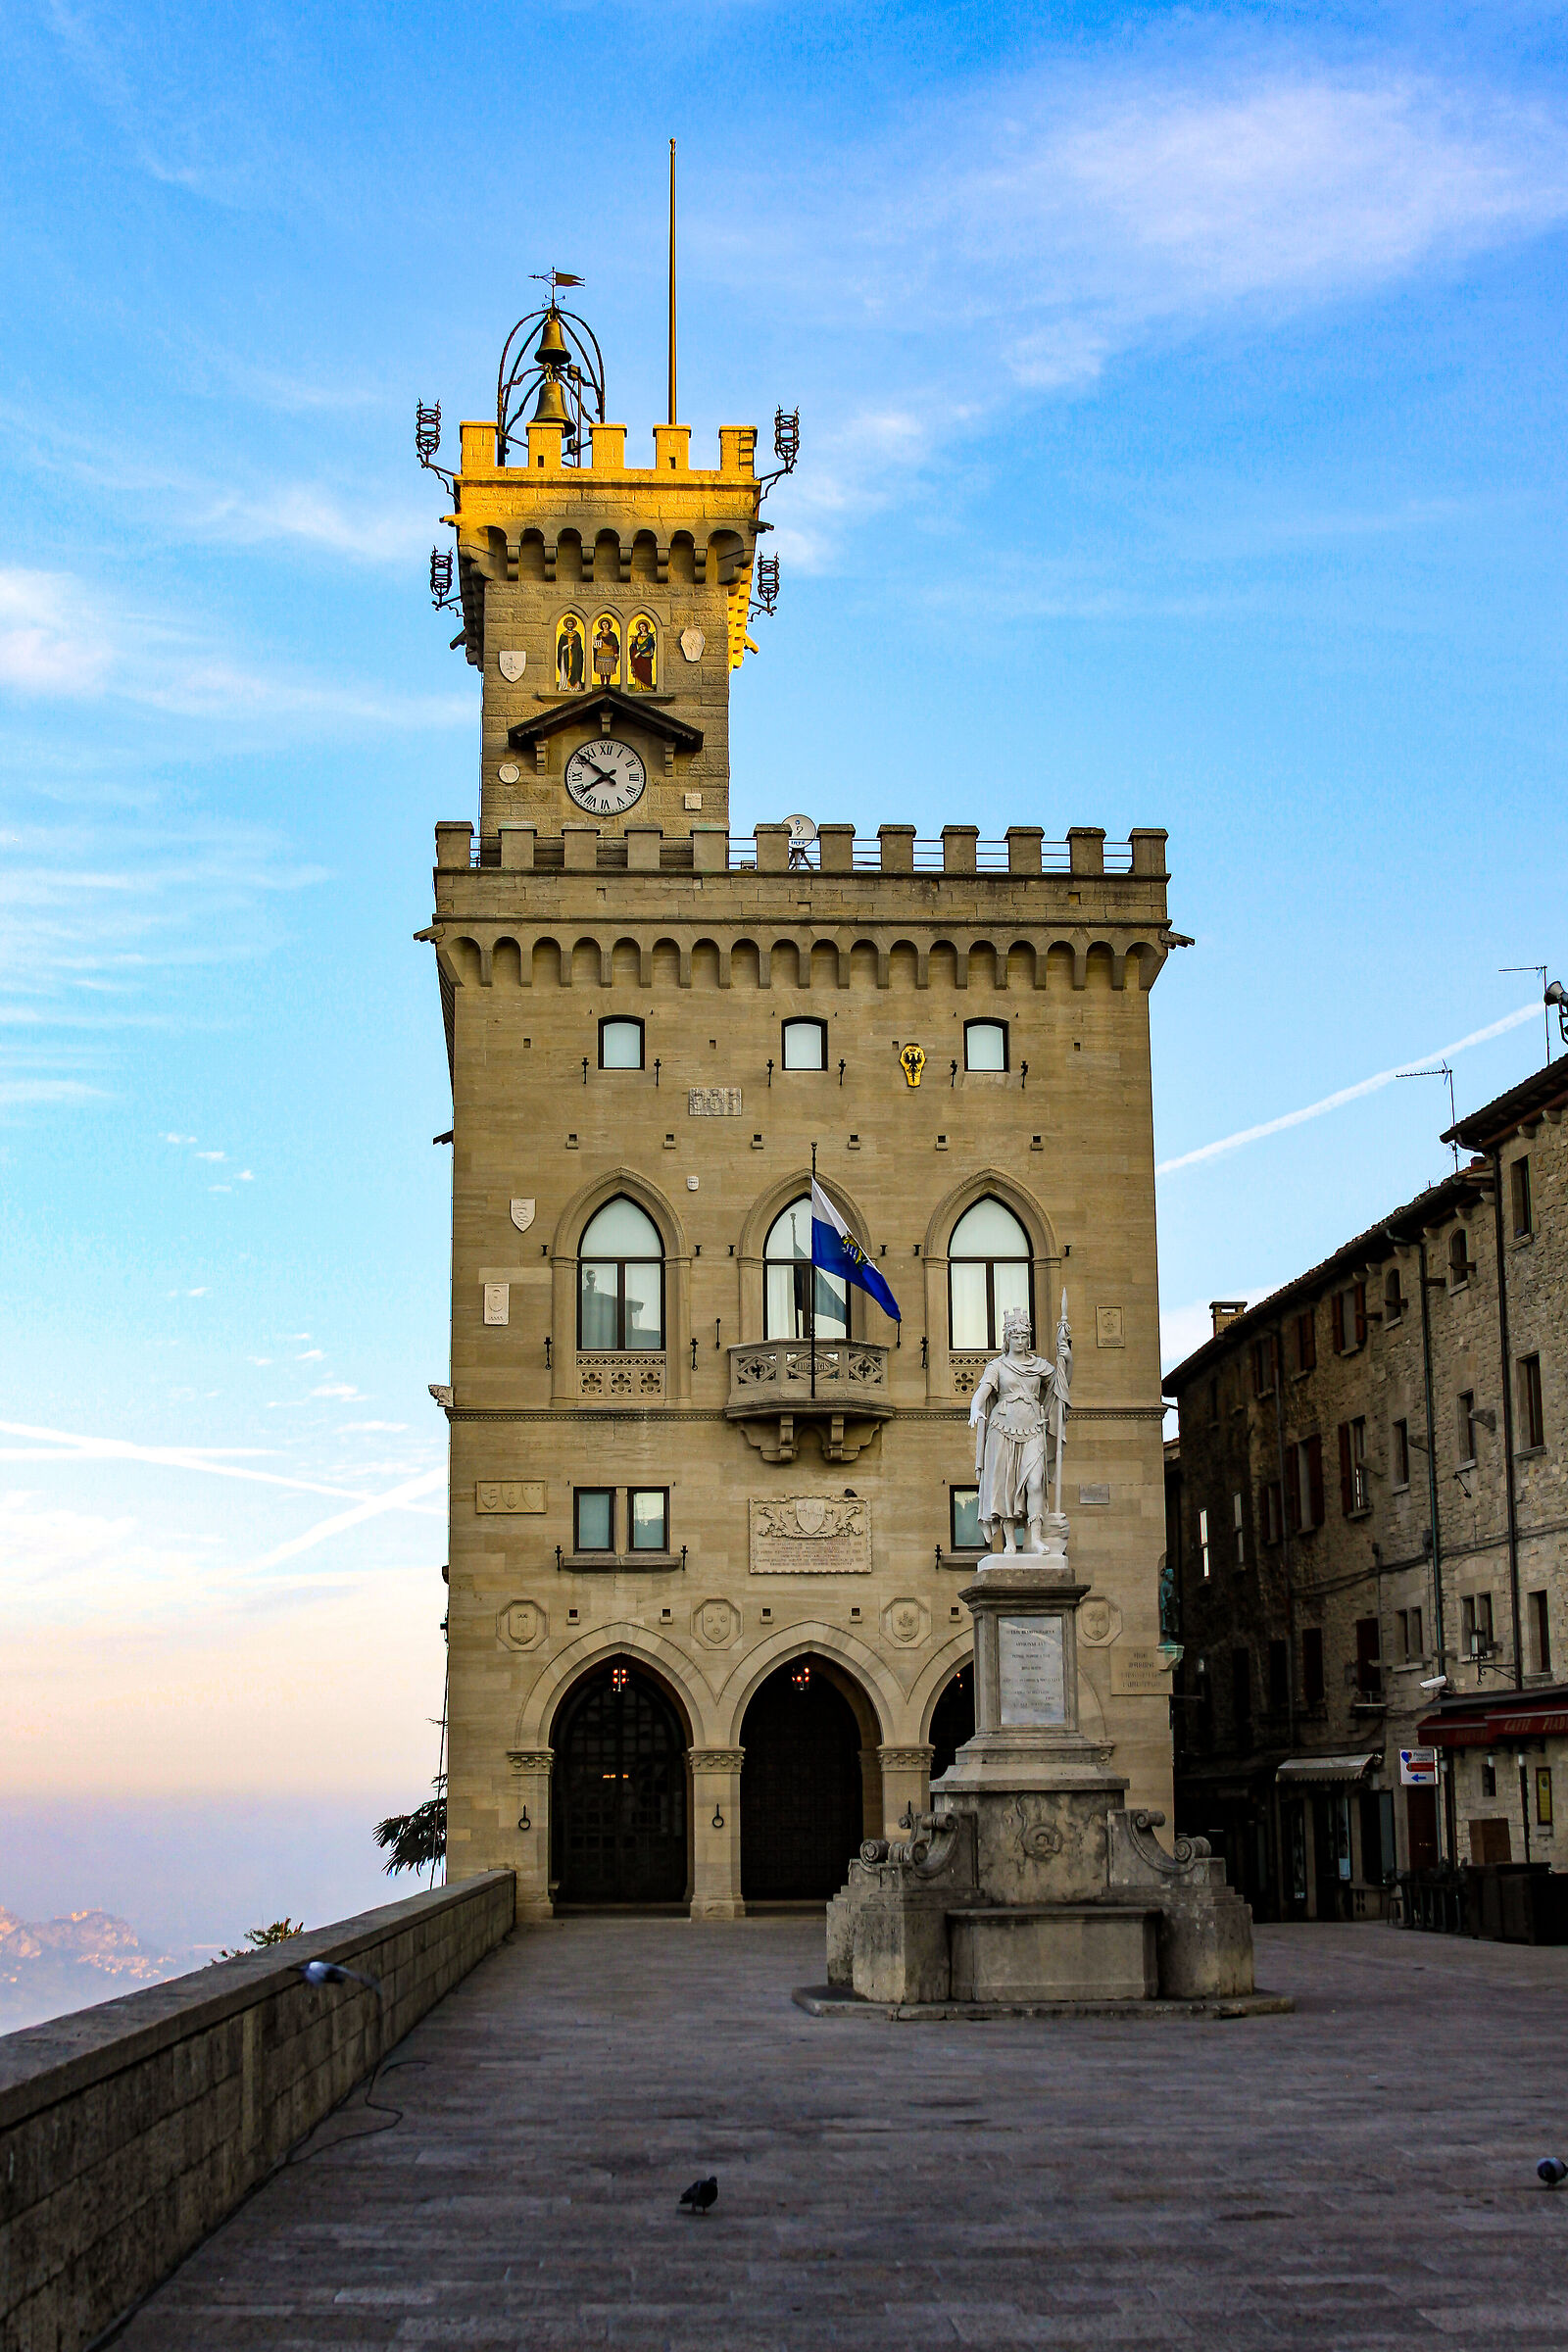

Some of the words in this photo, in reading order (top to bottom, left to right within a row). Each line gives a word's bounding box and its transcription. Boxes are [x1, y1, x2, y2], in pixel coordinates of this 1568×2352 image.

[584, 748, 597, 759] XI
[600, 745, 612, 756] XII
[625, 785, 637, 798] IV
[584, 795, 597, 808] VII
[601, 800, 610, 809] VI
[616, 796, 625, 807] V
[796, 1362, 830, 1371] LIBETAS
